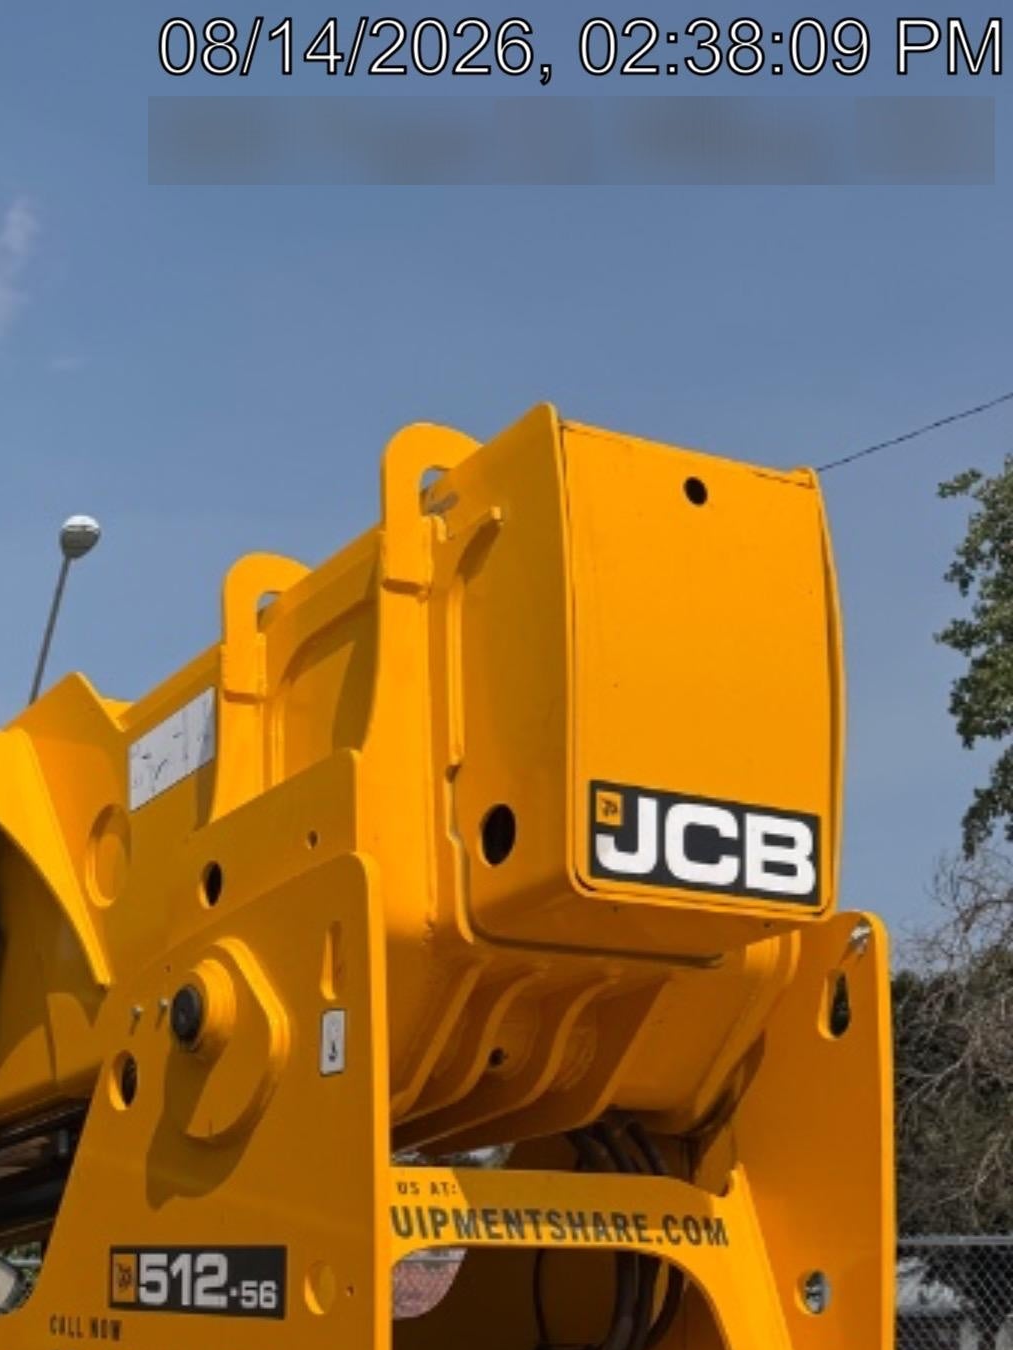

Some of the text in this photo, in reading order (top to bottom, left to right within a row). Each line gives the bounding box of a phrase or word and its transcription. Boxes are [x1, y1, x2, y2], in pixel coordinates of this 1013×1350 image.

[596, 796, 816, 895] JCB
[50, 1315, 122, 1341] CALL NOW
